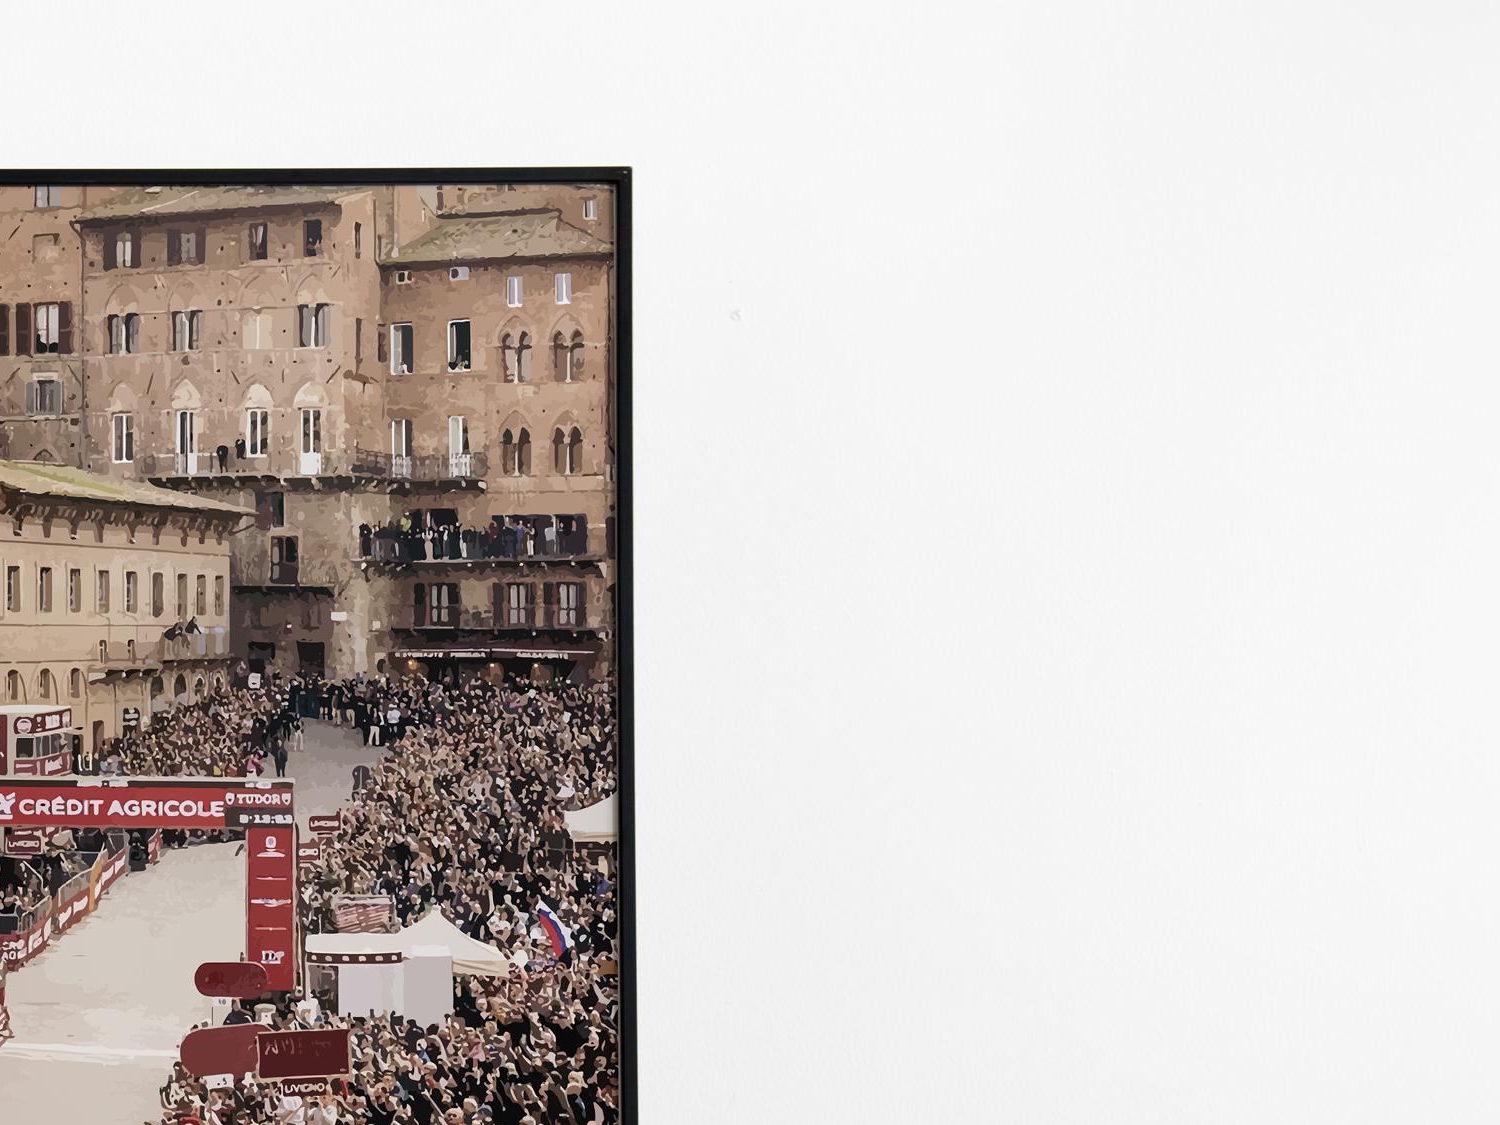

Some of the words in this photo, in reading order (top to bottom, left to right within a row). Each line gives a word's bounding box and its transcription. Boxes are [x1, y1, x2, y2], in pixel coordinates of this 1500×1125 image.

[18, 795, 105, 816] CRÉDIT
[107, 799, 225, 818] AGRICOLE
[236, 793, 281, 805] TUDOR
